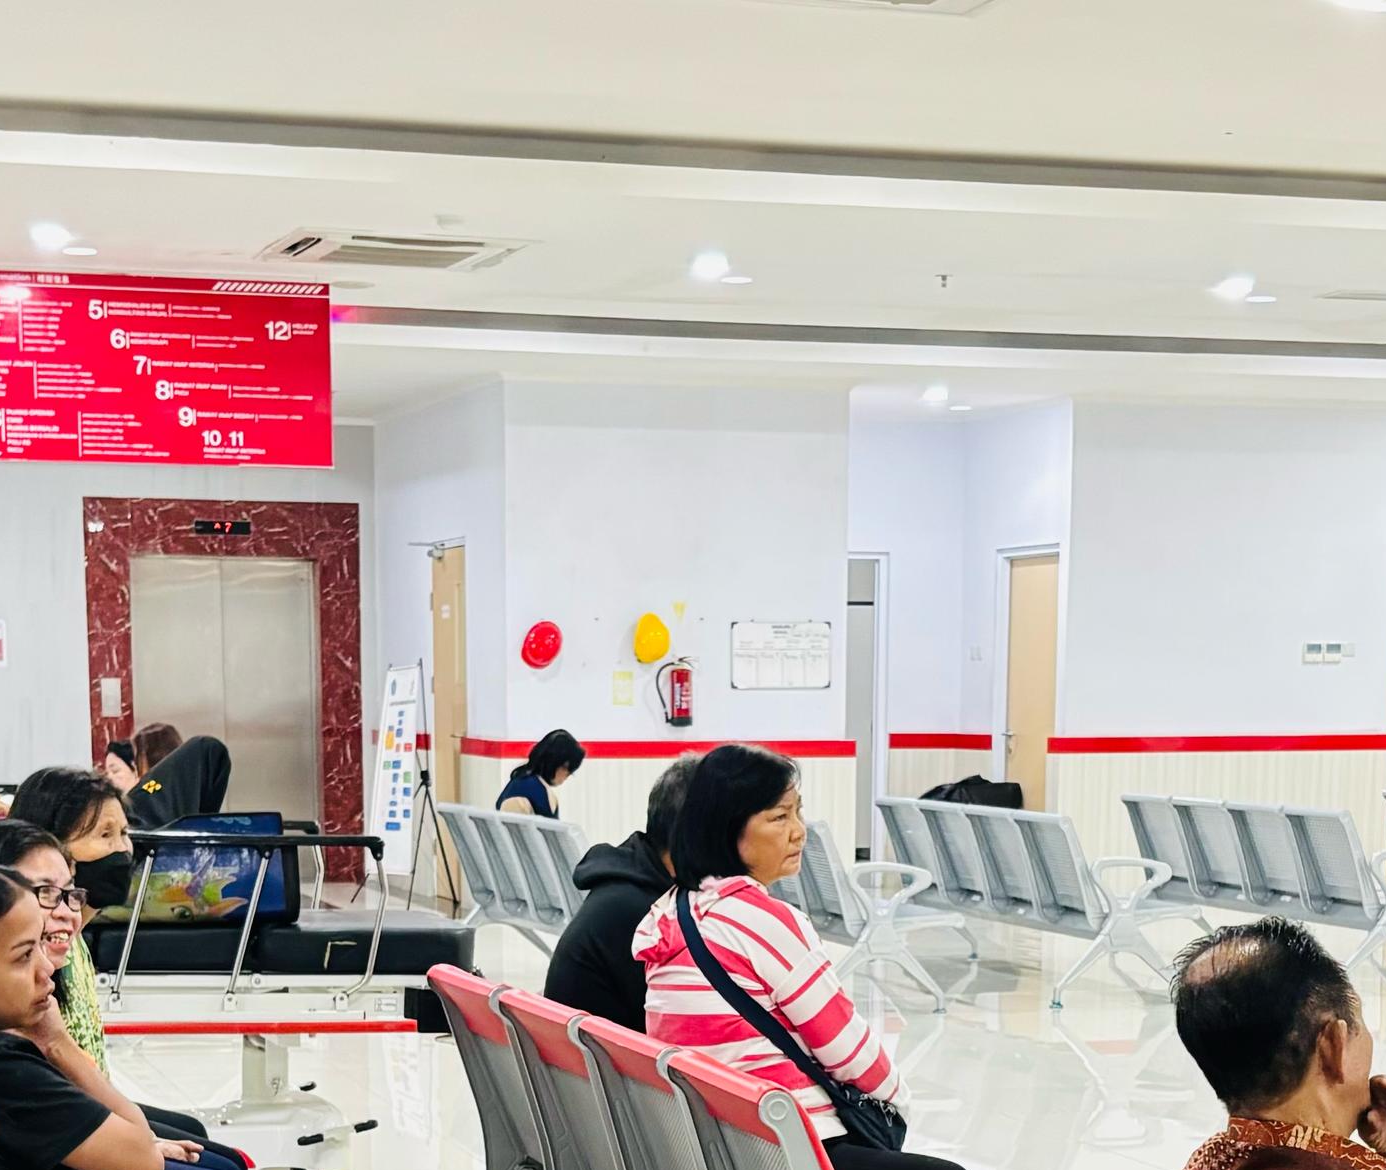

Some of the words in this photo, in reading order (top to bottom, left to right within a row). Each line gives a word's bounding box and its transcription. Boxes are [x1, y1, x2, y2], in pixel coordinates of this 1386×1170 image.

[88, 299, 103, 320] 5
[109, 328, 125, 350] 6
[264, 320, 289, 341] 12
[133, 355, 148, 376] 7
[155, 379, 171, 401] 8
[178, 406, 193, 427] 9
[201, 430, 222, 447] 10
[228, 430, 244, 447] 11
[224, 522, 232, 534] 7
